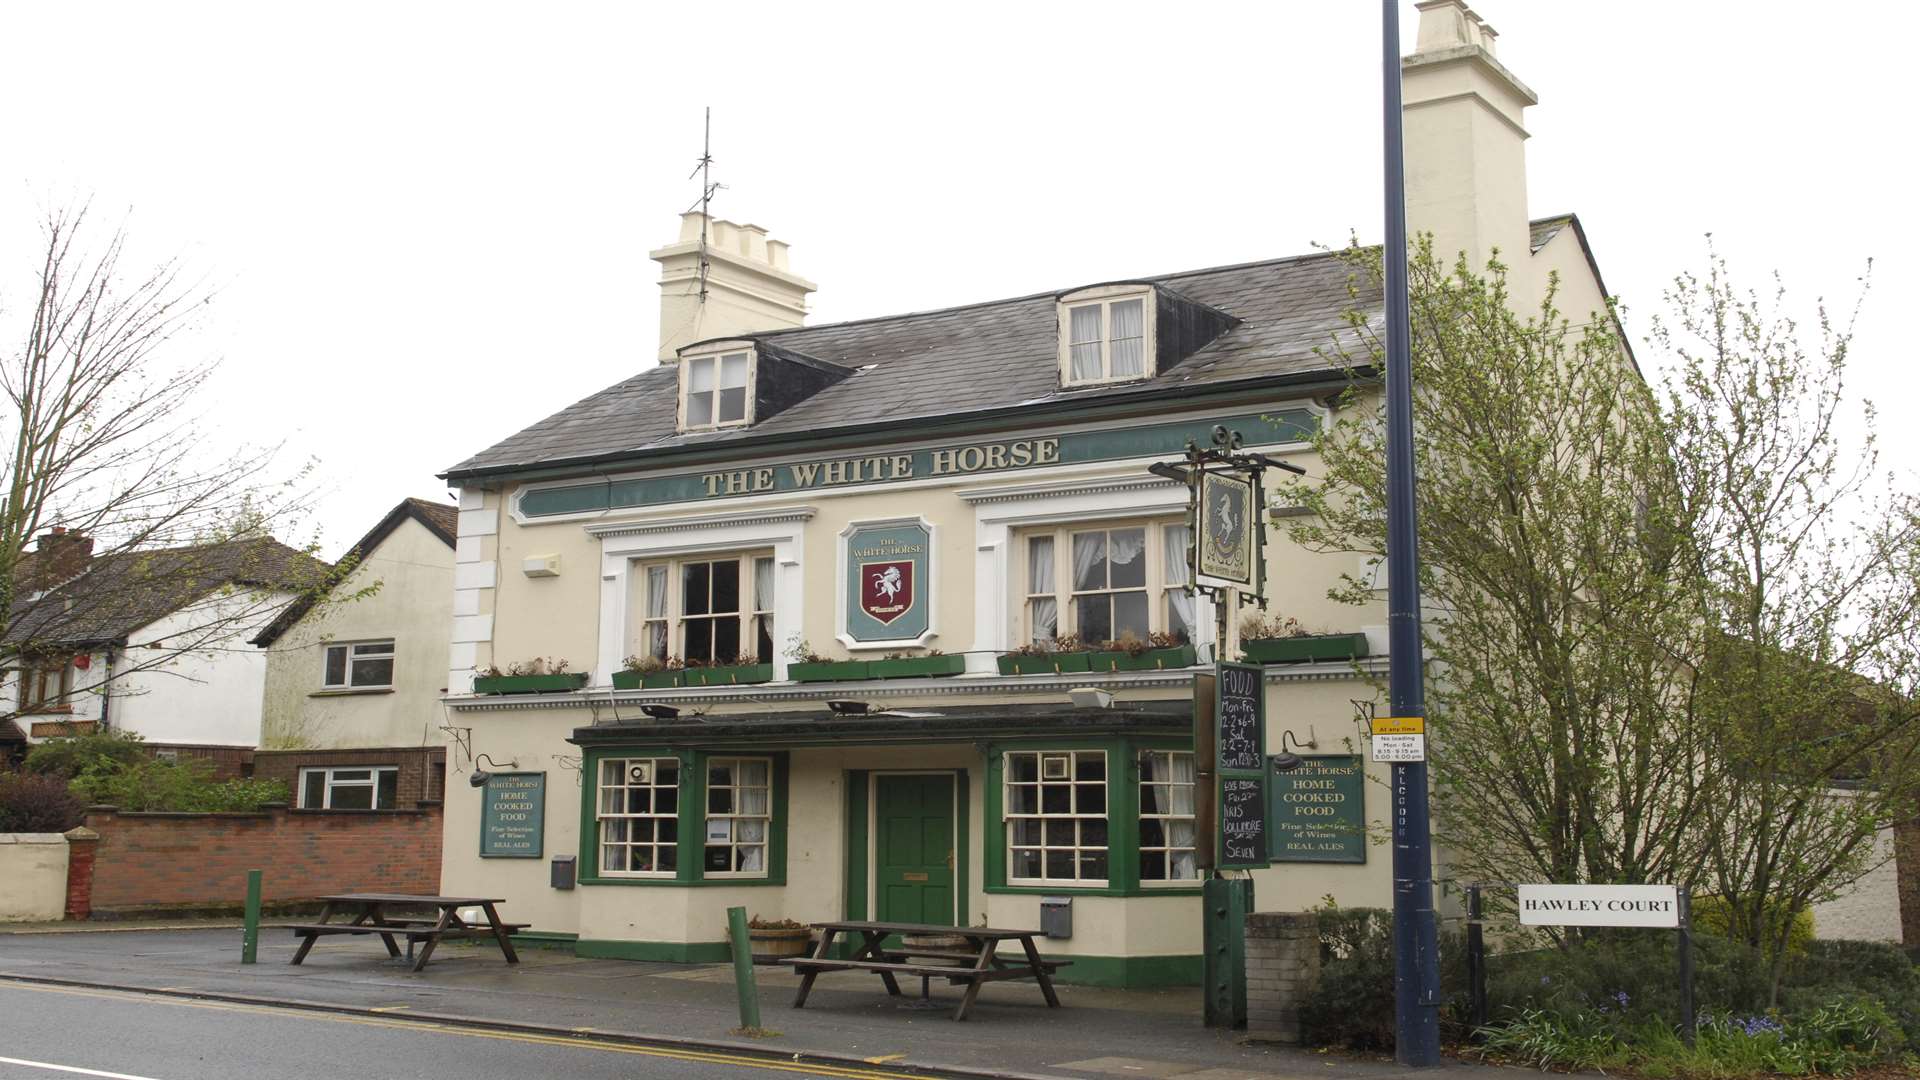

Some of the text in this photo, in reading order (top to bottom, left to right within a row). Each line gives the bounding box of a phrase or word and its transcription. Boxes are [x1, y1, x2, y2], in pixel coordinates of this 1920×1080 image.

[703, 438, 1060, 497] THE WHITE HORSE
[880, 538, 897, 546] THE
[854, 544, 923, 558] WHITE HORSE
[1222, 670, 1254, 695] FOOD
[1230, 728, 1245, 740] Sat
[1318, 767, 1354, 775] HORSE
[1293, 780, 1336, 789] HOME
[500, 791, 529, 800] HOME
[1283, 793, 1345, 802] COOKED
[494, 802, 533, 810] COOKED
[1295, 806, 1335, 816] FOOD
[500, 813, 526, 821] FOOD
[1281, 822, 1302, 830] Fine
[1525, 899, 1672, 912] HAWLEY COURT
